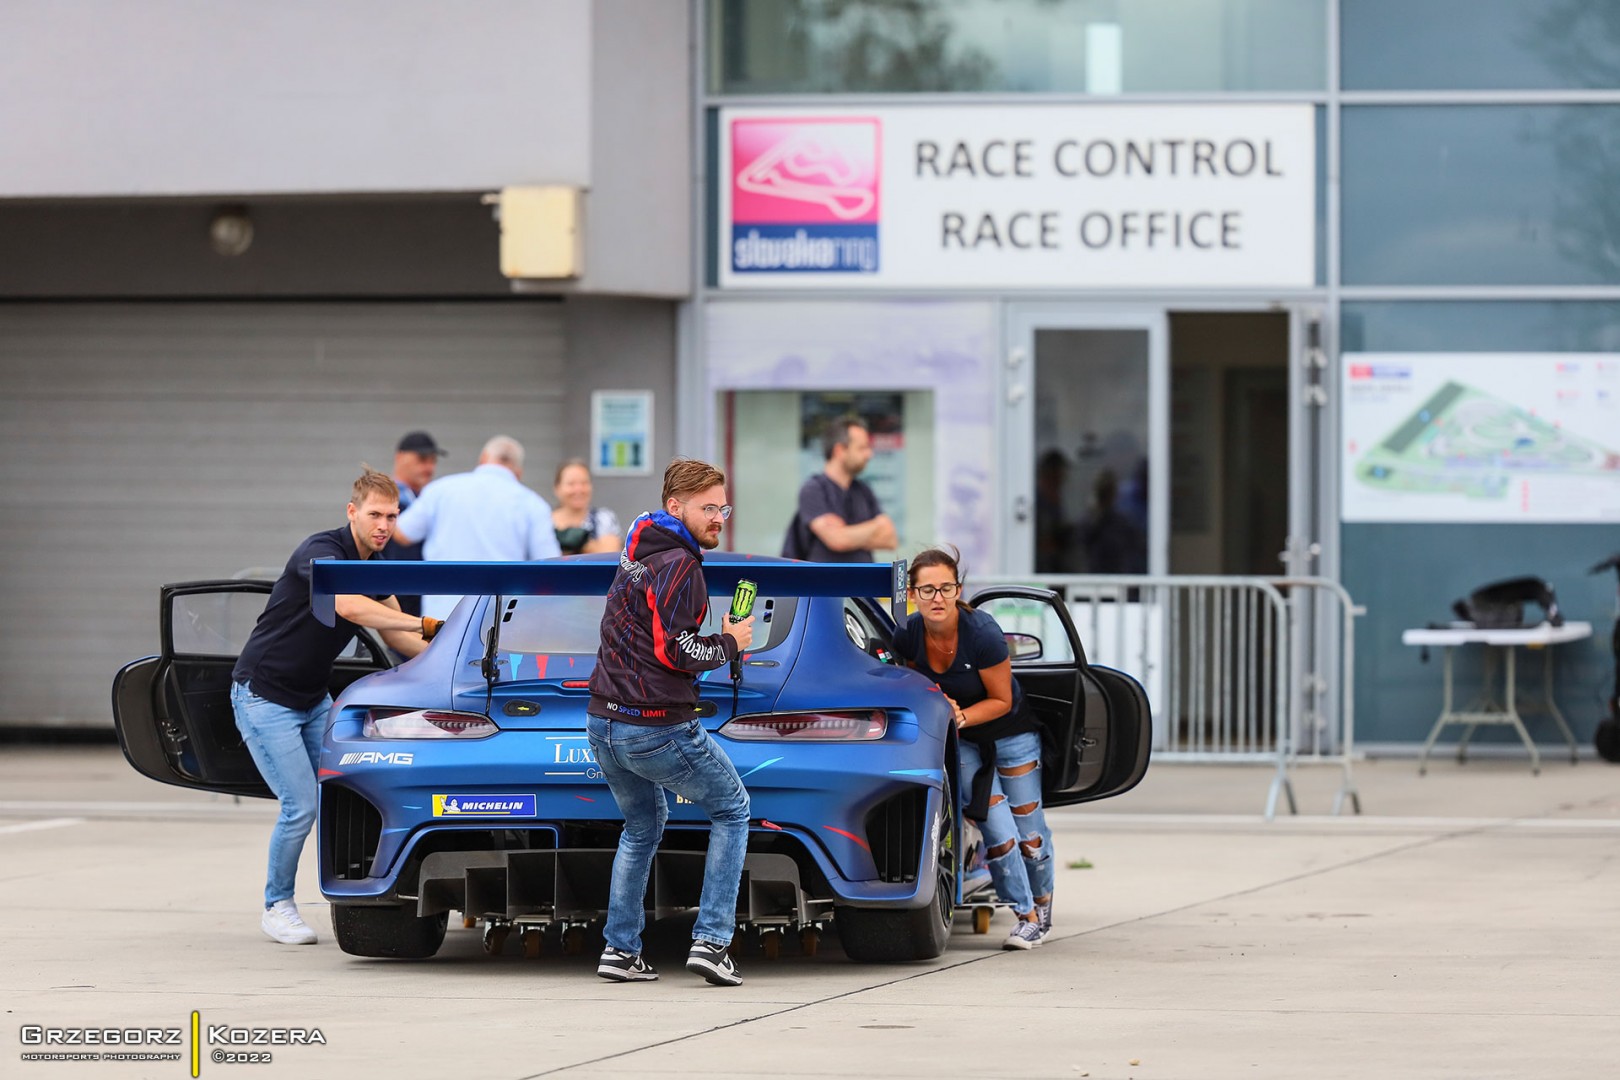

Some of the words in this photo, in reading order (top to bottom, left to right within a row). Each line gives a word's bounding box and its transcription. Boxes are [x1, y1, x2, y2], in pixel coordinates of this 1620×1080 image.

[916, 139, 1034, 178] RACE
[1054, 139, 1283, 178] CONTROL
[942, 211, 1060, 249] RACE
[1080, 211, 1241, 249] OFFICE
[606, 702, 618, 711] NO
[618, 705, 641, 717] SPEED
[642, 708, 667, 717] LIMIT
[358, 751, 414, 765] AMG
[462, 801, 524, 810] MICHELIN
